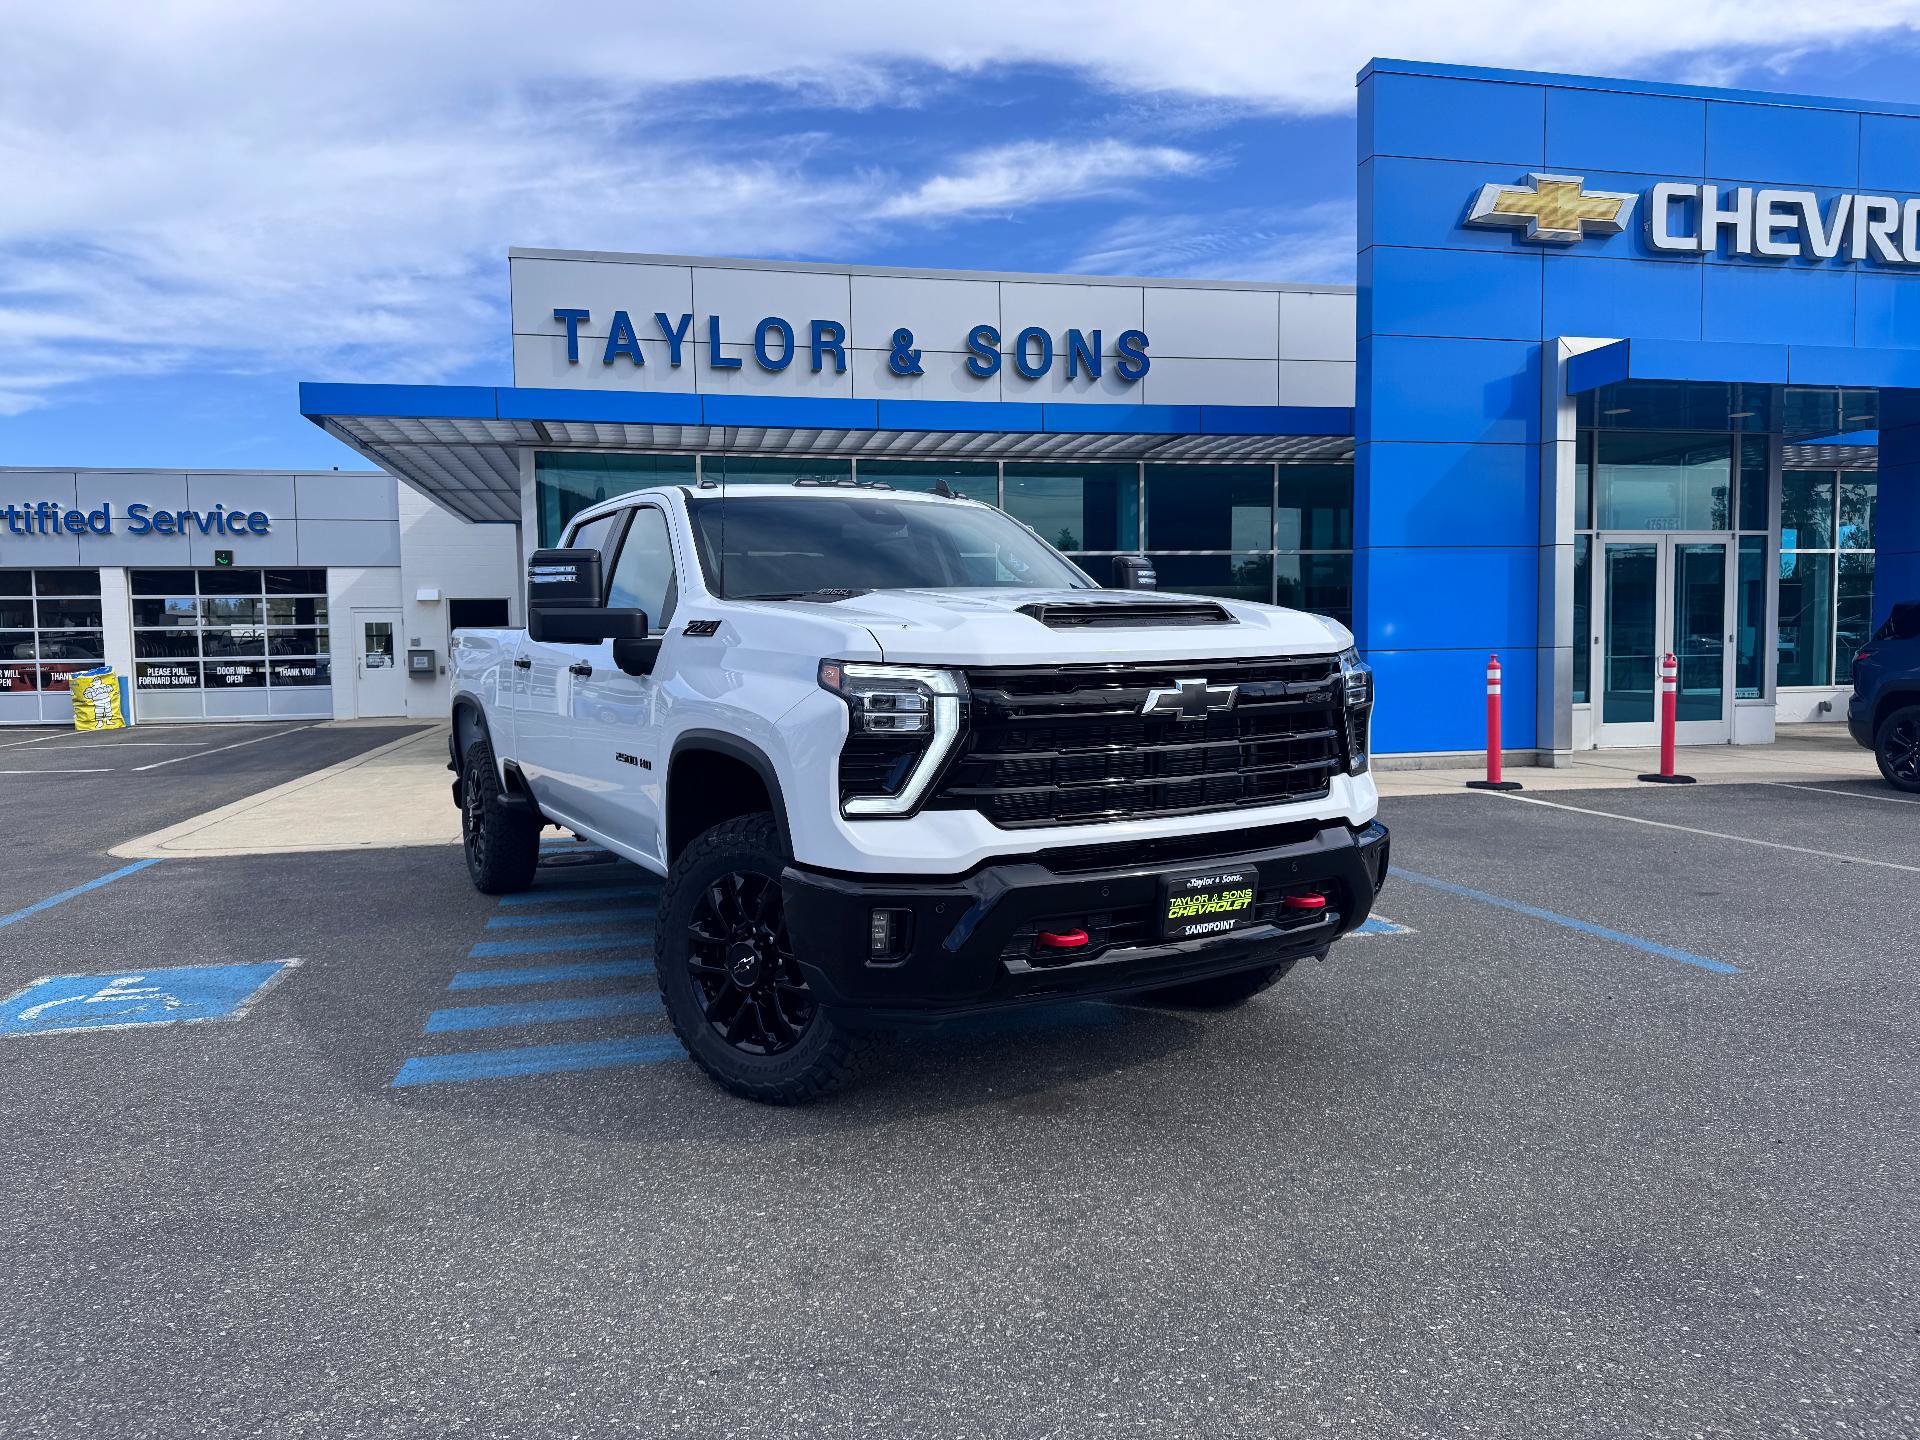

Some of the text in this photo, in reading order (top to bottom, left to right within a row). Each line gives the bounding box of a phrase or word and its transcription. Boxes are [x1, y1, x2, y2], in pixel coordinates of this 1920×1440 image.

[553, 308, 1151, 380] TAYLOR & SONS
[127, 502, 270, 534] Service
[3, 669, 21, 678] WILL
[147, 667, 189, 676] PLEASE PULL
[216, 666, 251, 675] DOOR WILL
[280, 667, 316, 676] THANK YOU!
[51, 672, 71, 681] THAN
[138, 676, 197, 685] FORWARD SLOWLY
[226, 675, 243, 683] OPEN
[615, 751, 652, 770] 2500 HD
[1190, 876, 1214, 888] Taylor
[1222, 875, 1240, 883] Sons
[1169, 889, 1252, 907] TAYLOR & SONS
[1168, 898, 1252, 919] CHEVROLET
[1185, 920, 1236, 935] SANDPOINT
